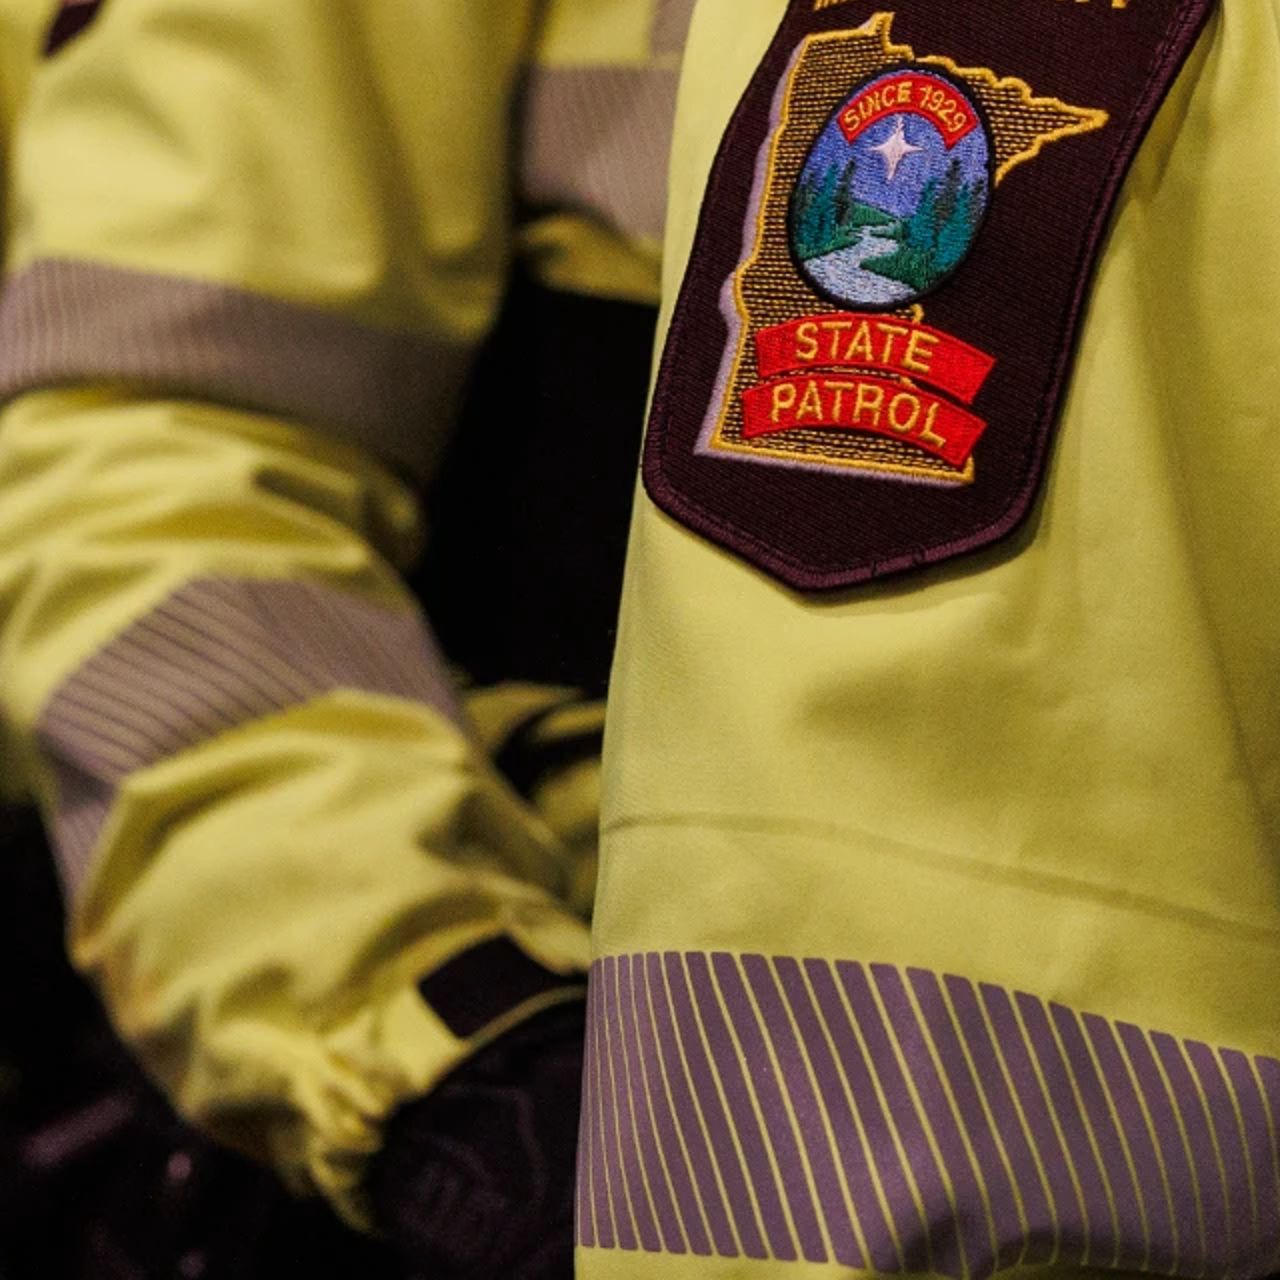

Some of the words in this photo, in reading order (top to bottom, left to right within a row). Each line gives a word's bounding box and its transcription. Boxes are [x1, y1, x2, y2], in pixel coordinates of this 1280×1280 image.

[844, 81, 913, 132] SINCE
[920, 84, 967, 133] 1929
[796, 321, 940, 373] STATE
[771, 380, 946, 448] PATROL
